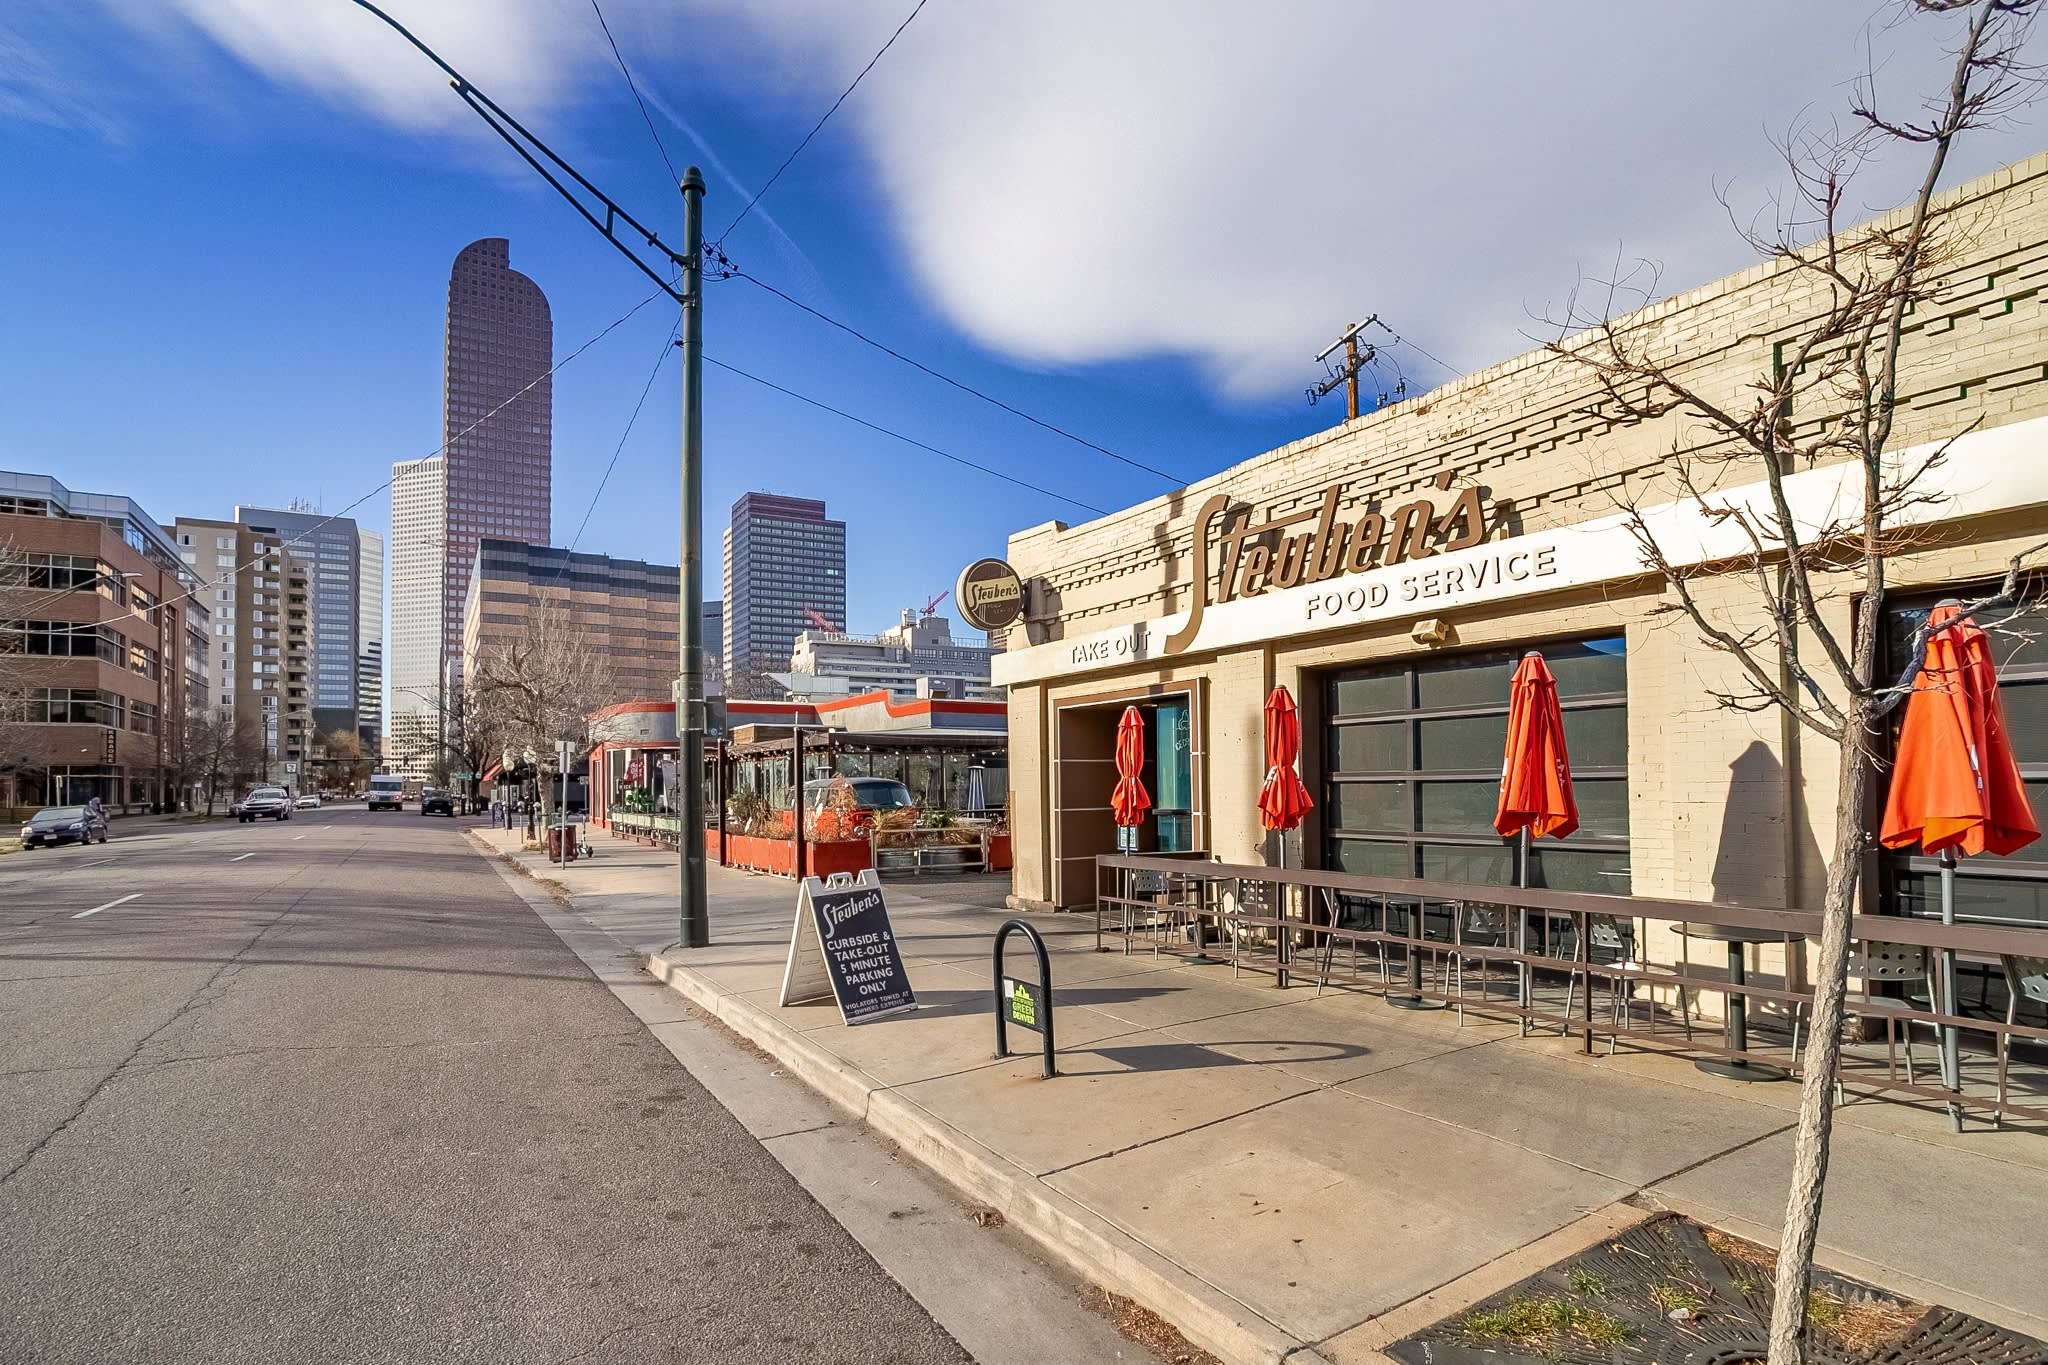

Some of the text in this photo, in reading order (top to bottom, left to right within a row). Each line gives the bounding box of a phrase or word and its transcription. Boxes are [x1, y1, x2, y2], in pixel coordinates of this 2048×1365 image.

[1164, 470, 1487, 654] Steuben's
[1305, 545, 1557, 619] FOOD SERVICE
[971, 584, 1018, 612] Steuben's
[1071, 631, 1151, 664] TAKE OUT
[822, 891, 880, 939] Steuben's
[827, 931, 891, 951] CURBSIDE &
[834, 943, 889, 962] TAKE-OUT
[840, 955, 892, 974] 5 MINUTE
[845, 967, 894, 986] PARKING
[859, 980, 887, 995] ONLY
[845, 990, 909, 1011] VIOLATORS TOWED AT
[1012, 1001, 1035, 1017] GREEN
[1012, 1010, 1036, 1025] DENVER
